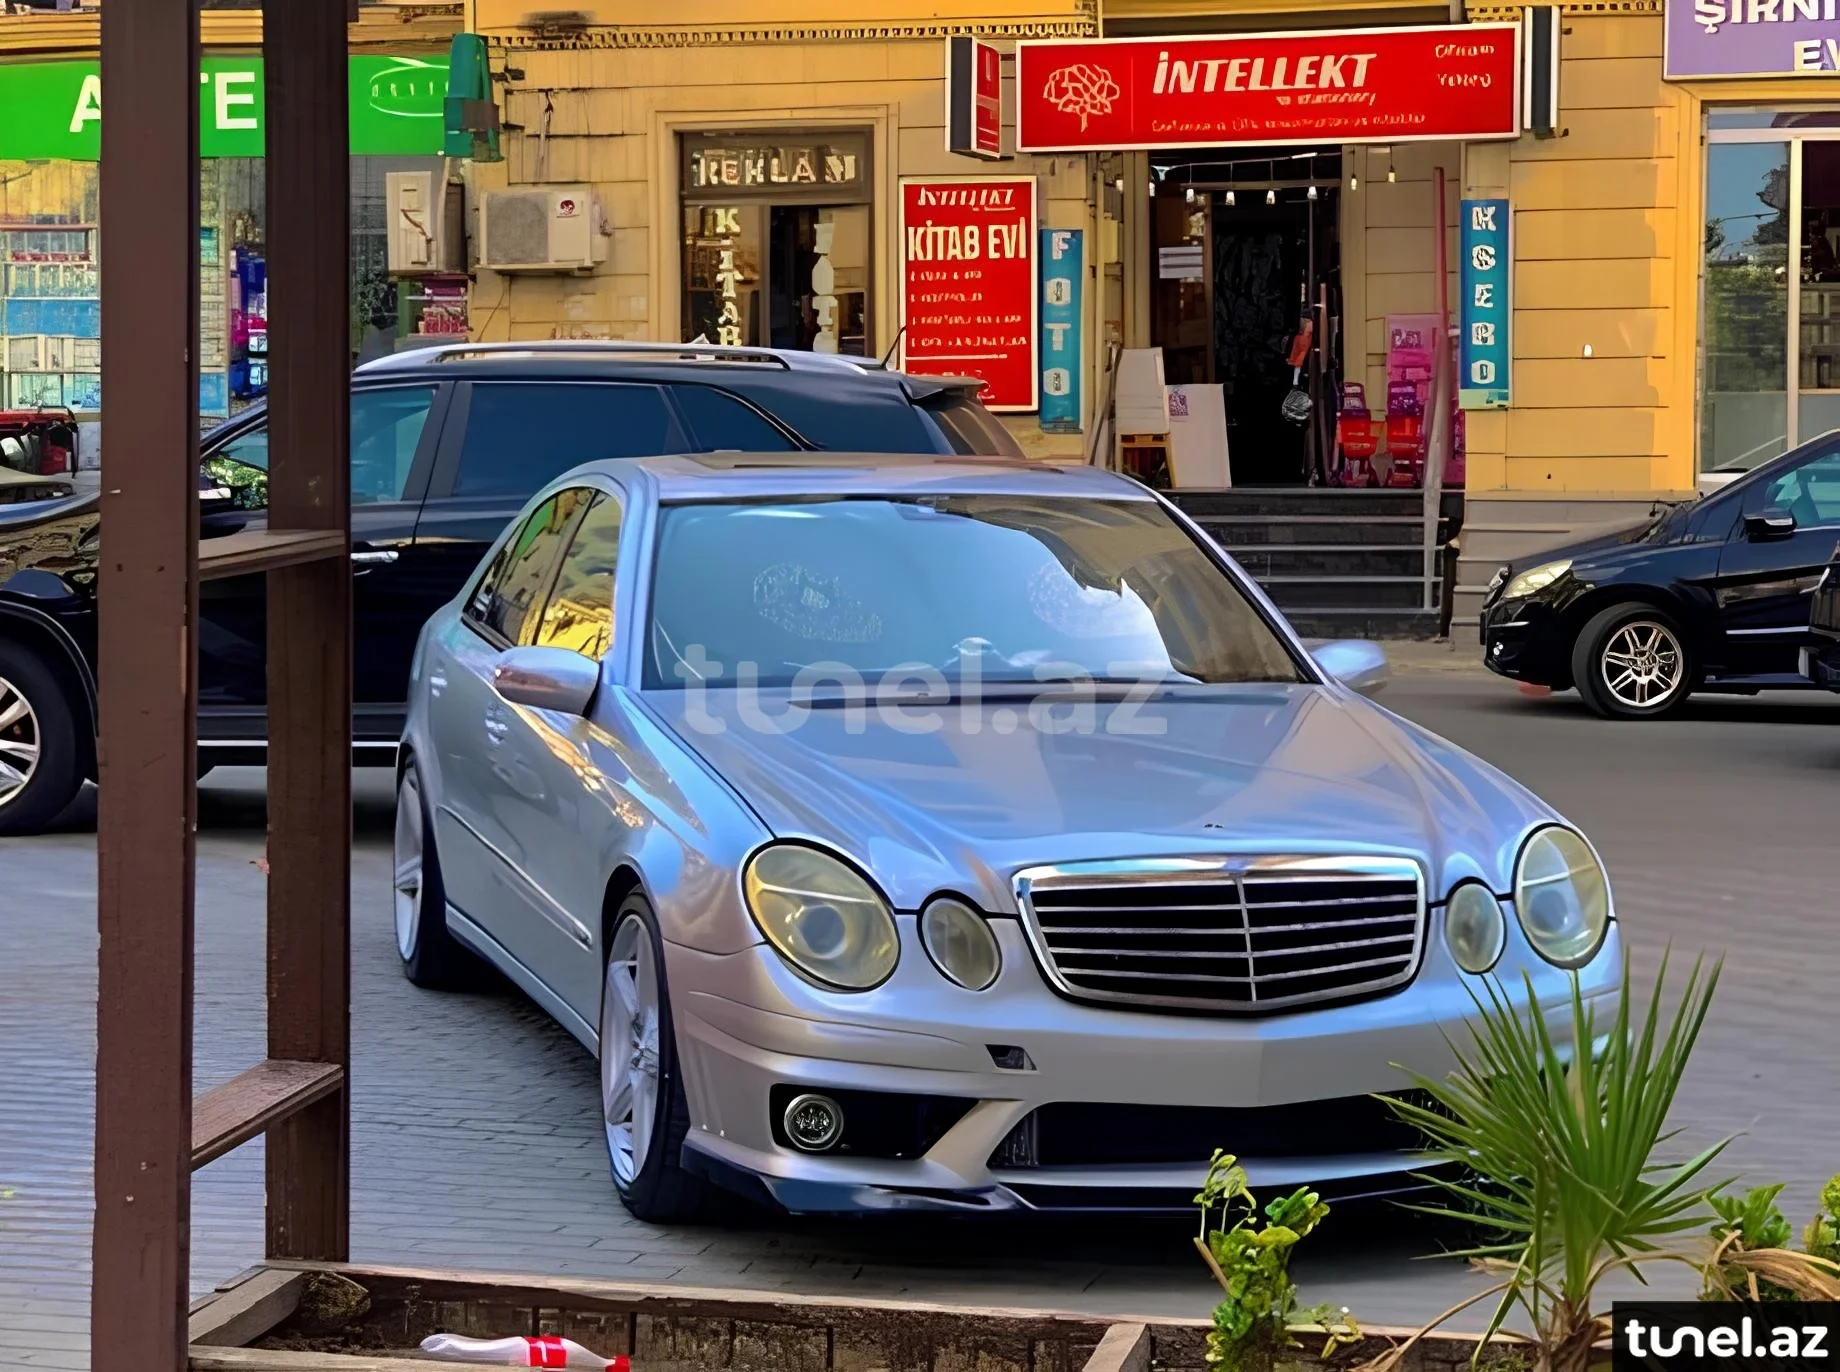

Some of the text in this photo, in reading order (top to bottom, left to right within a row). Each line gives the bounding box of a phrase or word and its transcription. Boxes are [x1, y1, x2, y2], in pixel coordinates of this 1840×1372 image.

[1152, 51, 1377, 94] İNTELLEKT
[907, 219, 980, 261] KİTAB
[1043, 231, 1072, 396] FOTO
